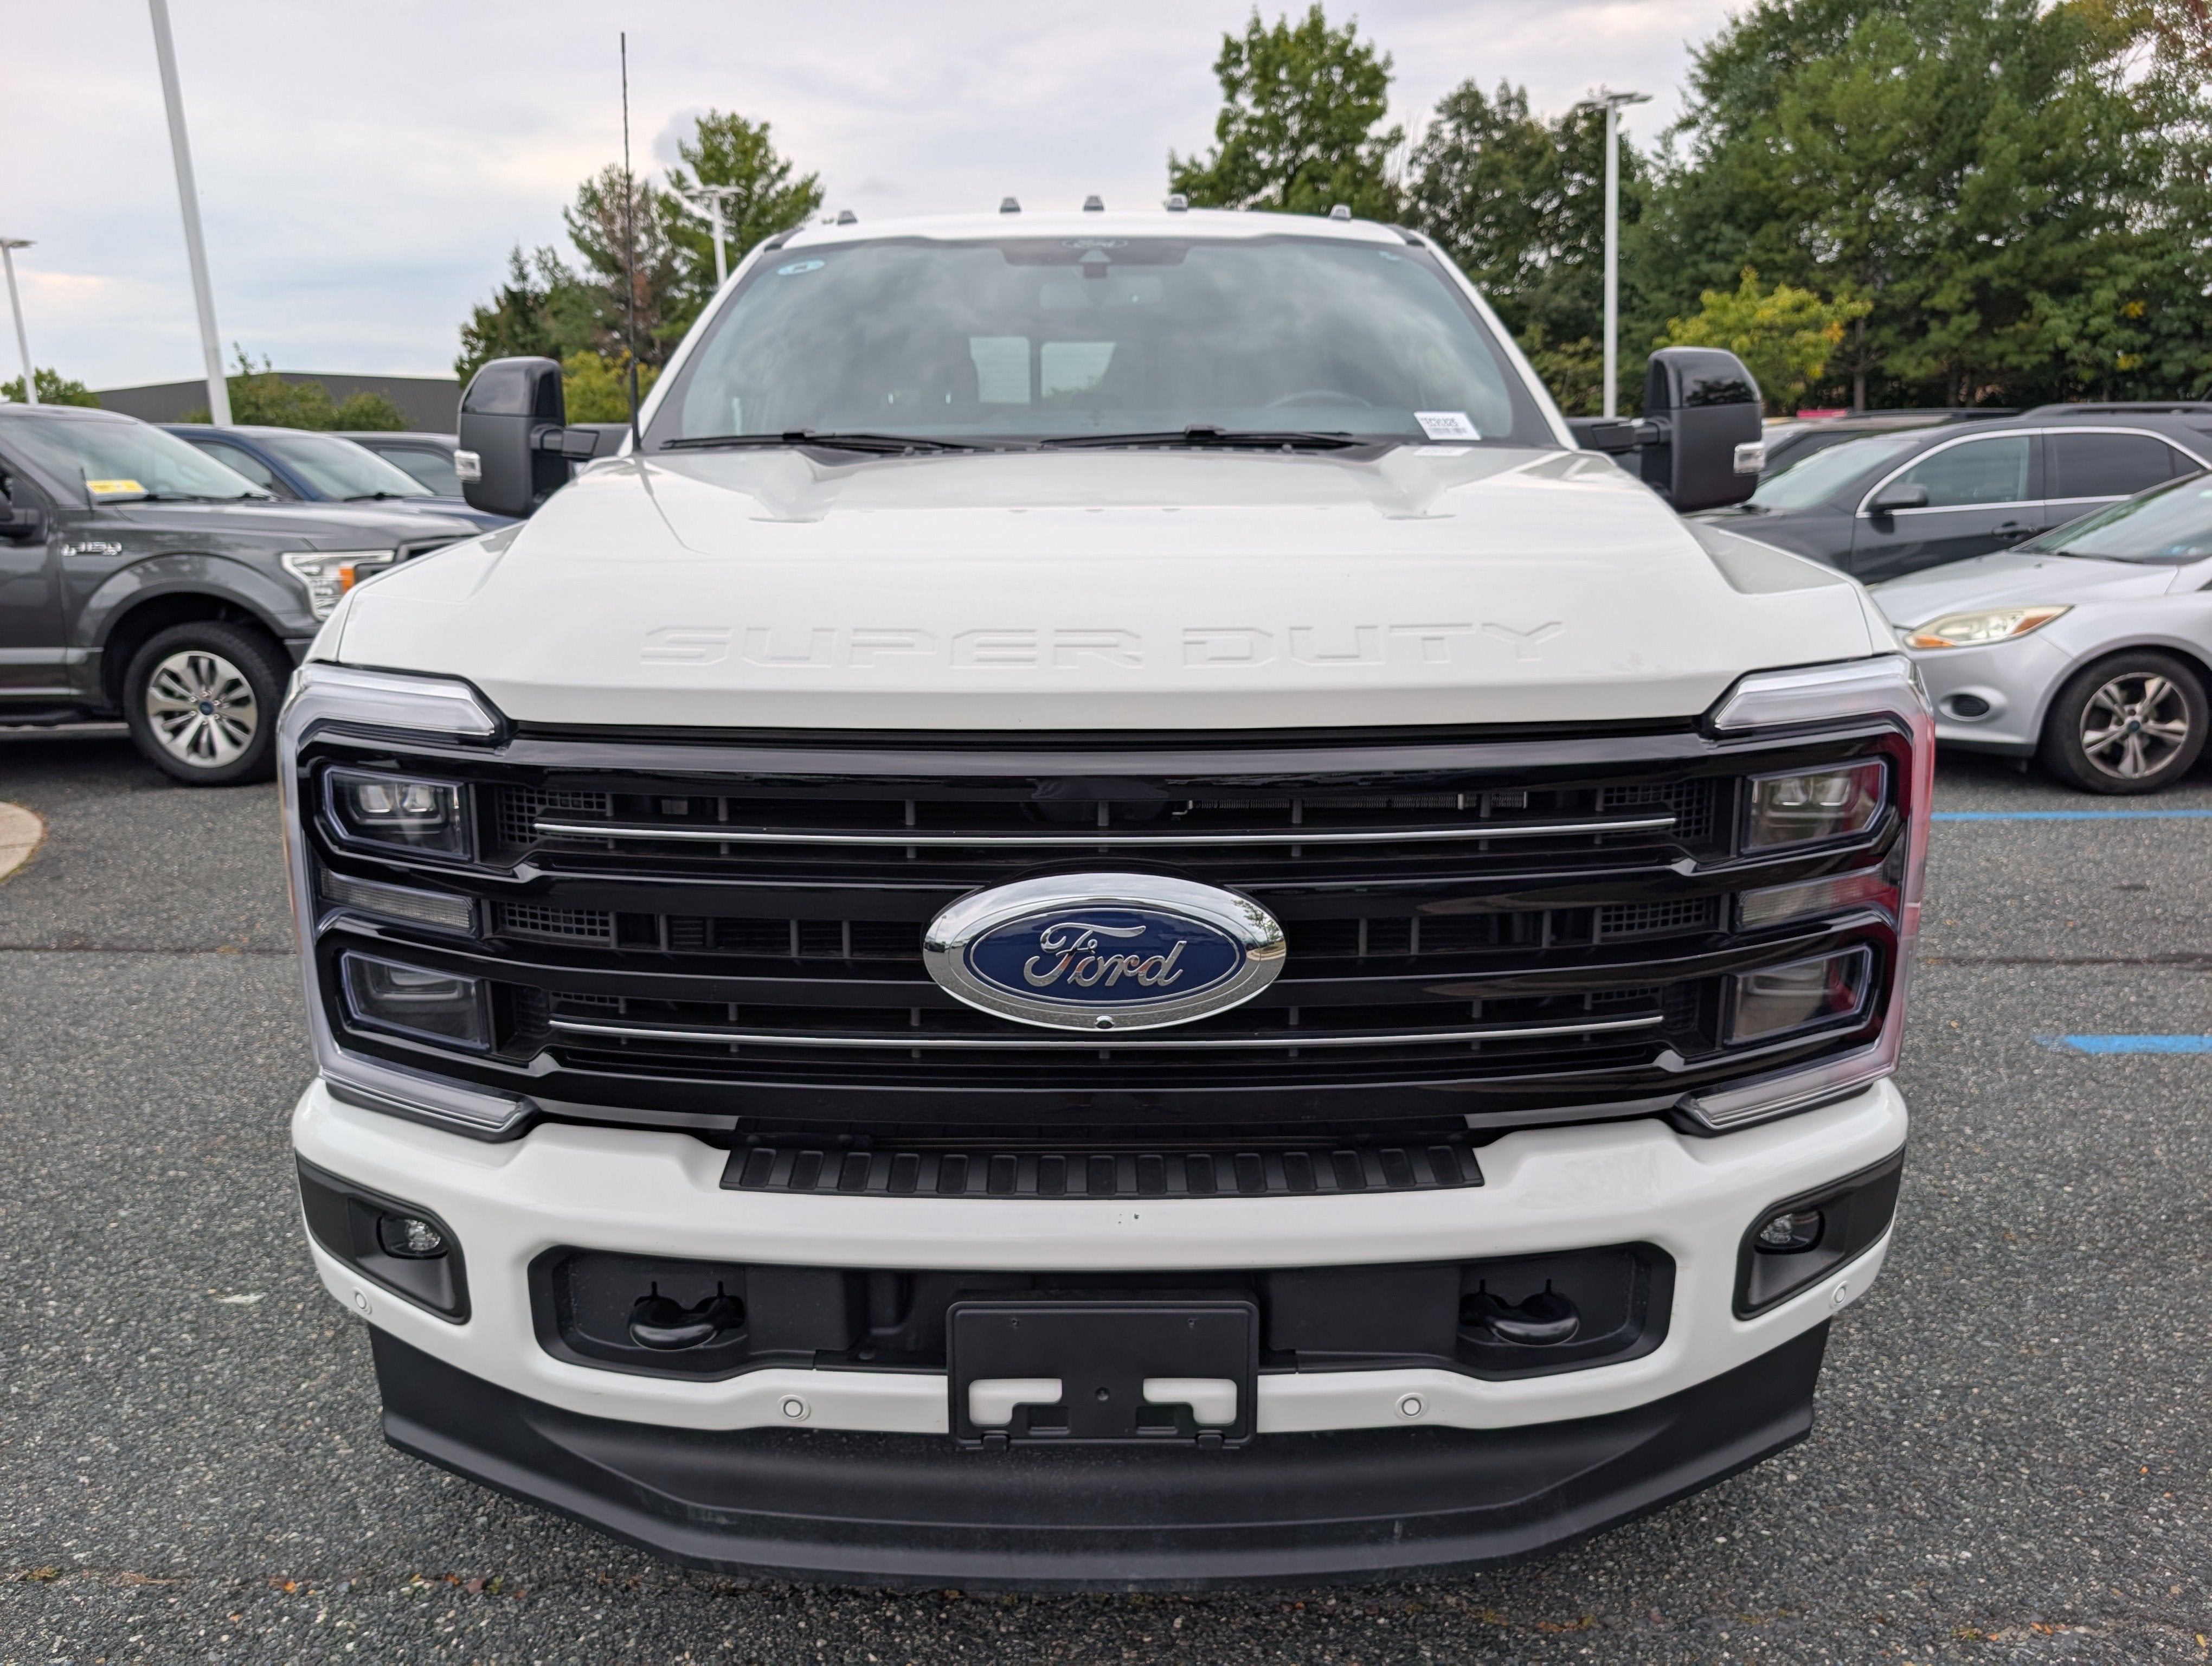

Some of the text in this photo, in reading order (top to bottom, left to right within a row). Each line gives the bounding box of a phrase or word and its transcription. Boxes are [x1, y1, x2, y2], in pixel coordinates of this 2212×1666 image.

[640, 620, 1566, 670] SUPER DUTY
[1023, 922, 1187, 987] Ford
